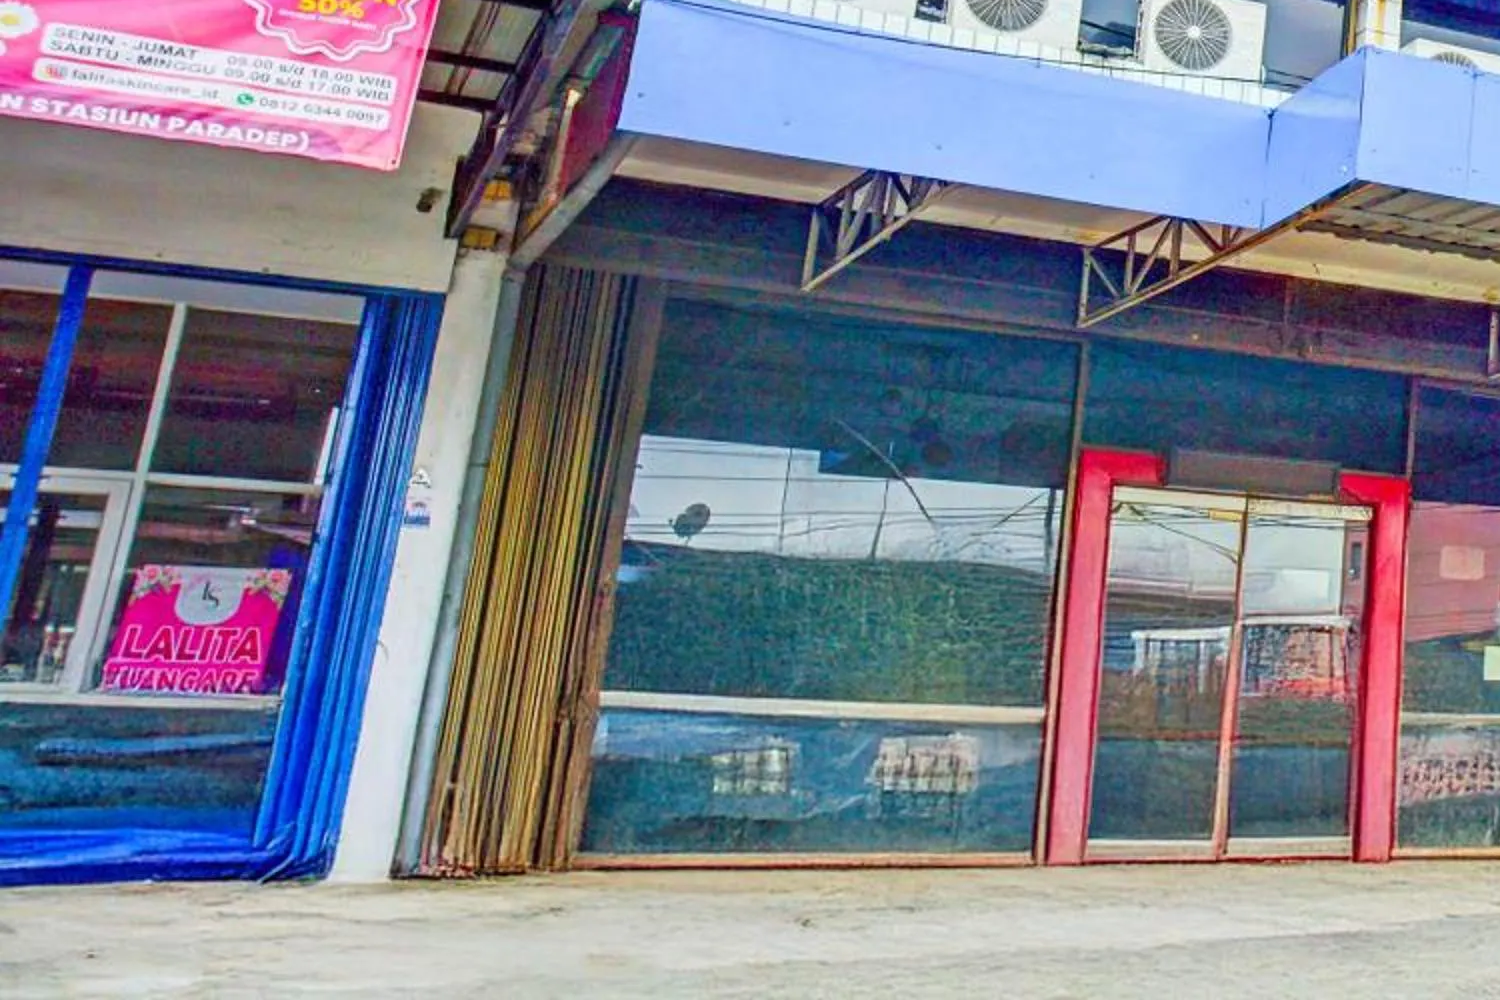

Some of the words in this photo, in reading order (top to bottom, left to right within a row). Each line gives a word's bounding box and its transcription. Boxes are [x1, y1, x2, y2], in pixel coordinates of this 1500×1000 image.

[50, 40, 119, 61] SABTU
[137, 55, 216, 76] MINGGU
[224, 67, 270, 83] 09.00
[308, 80, 351, 96] 17.00
[53, 26, 116, 45] SENIN
[133, 40, 199, 60] JUMAT
[227, 55, 274, 70] 09.00
[311, 67, 354, 83] 18.00
[31, 97, 161, 129] STASIUN
[167, 115, 310, 151] PARADEP)
[118, 623, 262, 665] LALITA
